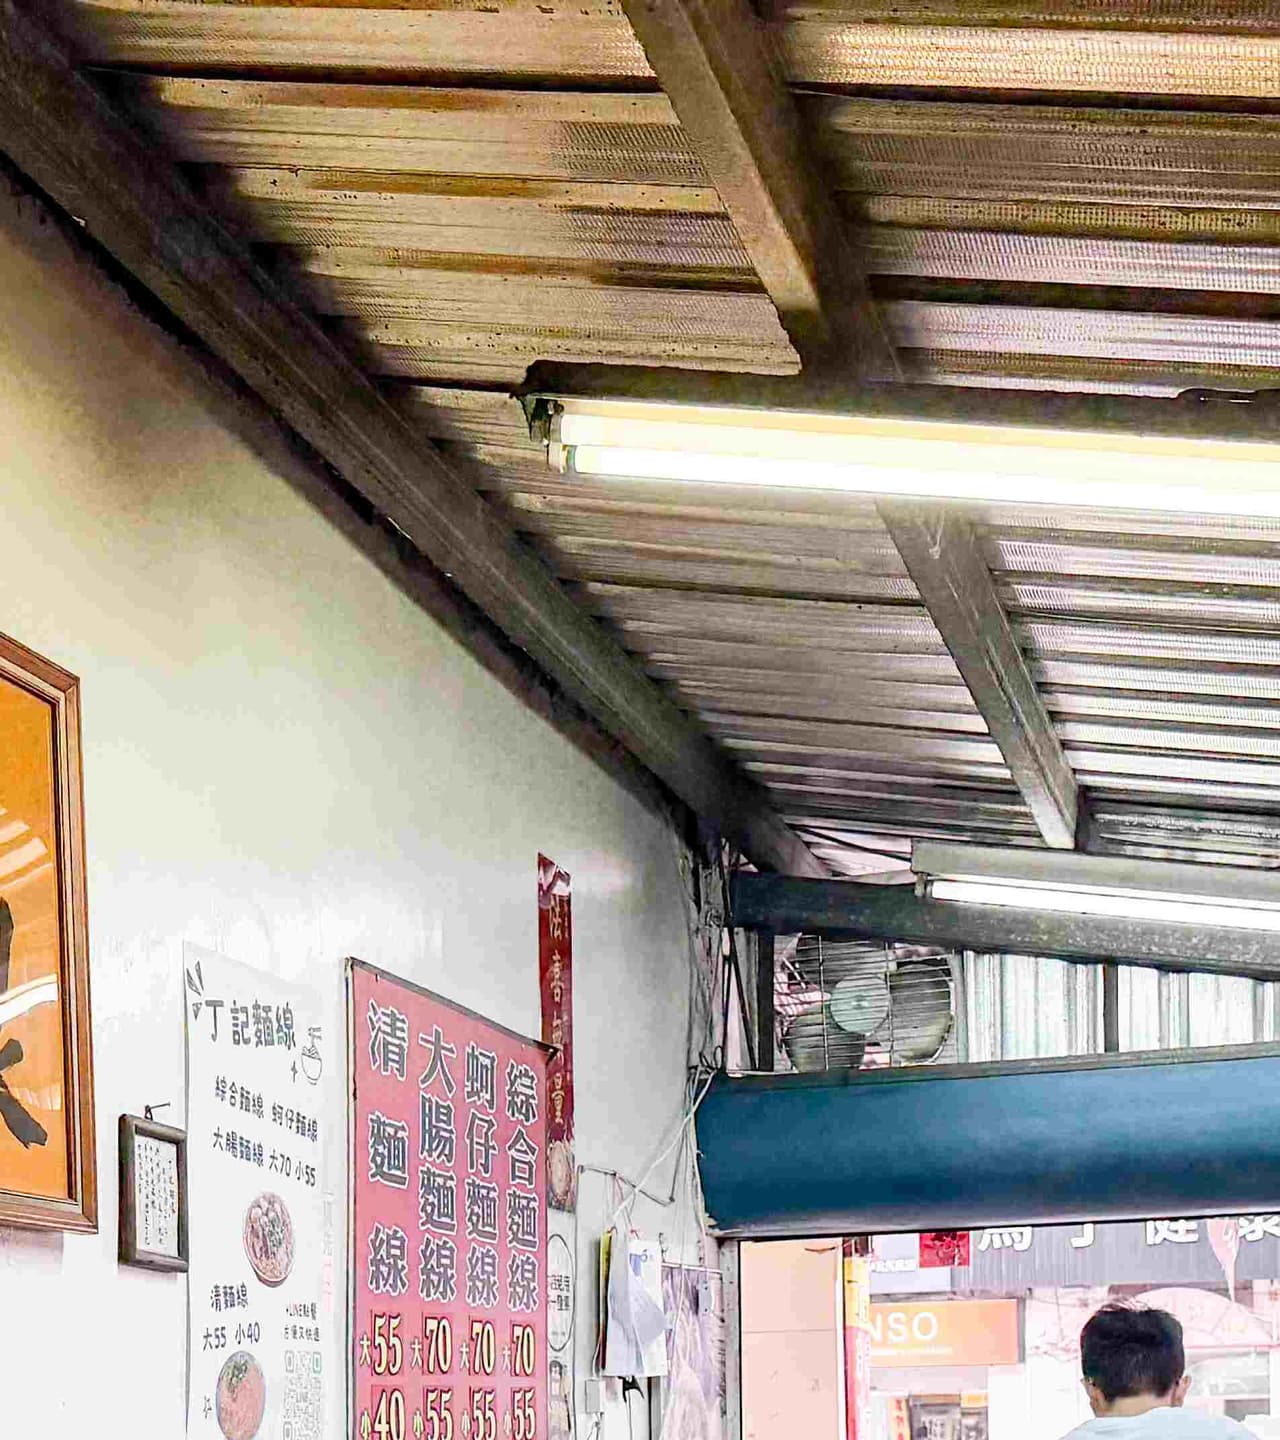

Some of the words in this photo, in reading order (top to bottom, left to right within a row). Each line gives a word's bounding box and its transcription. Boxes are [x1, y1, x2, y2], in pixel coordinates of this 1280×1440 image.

[205, 999, 296, 1051] 丁記麵線
[213, 1127, 264, 1167] 大腸麵線
[215, 1075, 264, 1119] 綜合麵線
[272, 1102, 318, 1143] 蚵仔麵線
[367, 998, 408, 1296] 清麵線
[418, 1024, 457, 1302] 大腸麵線
[464, 1041, 497, 1309] 蚵仔麵線
[506, 1059, 539, 1312] 綜合麵線
[210, 1281, 249, 1313] 清麵線
